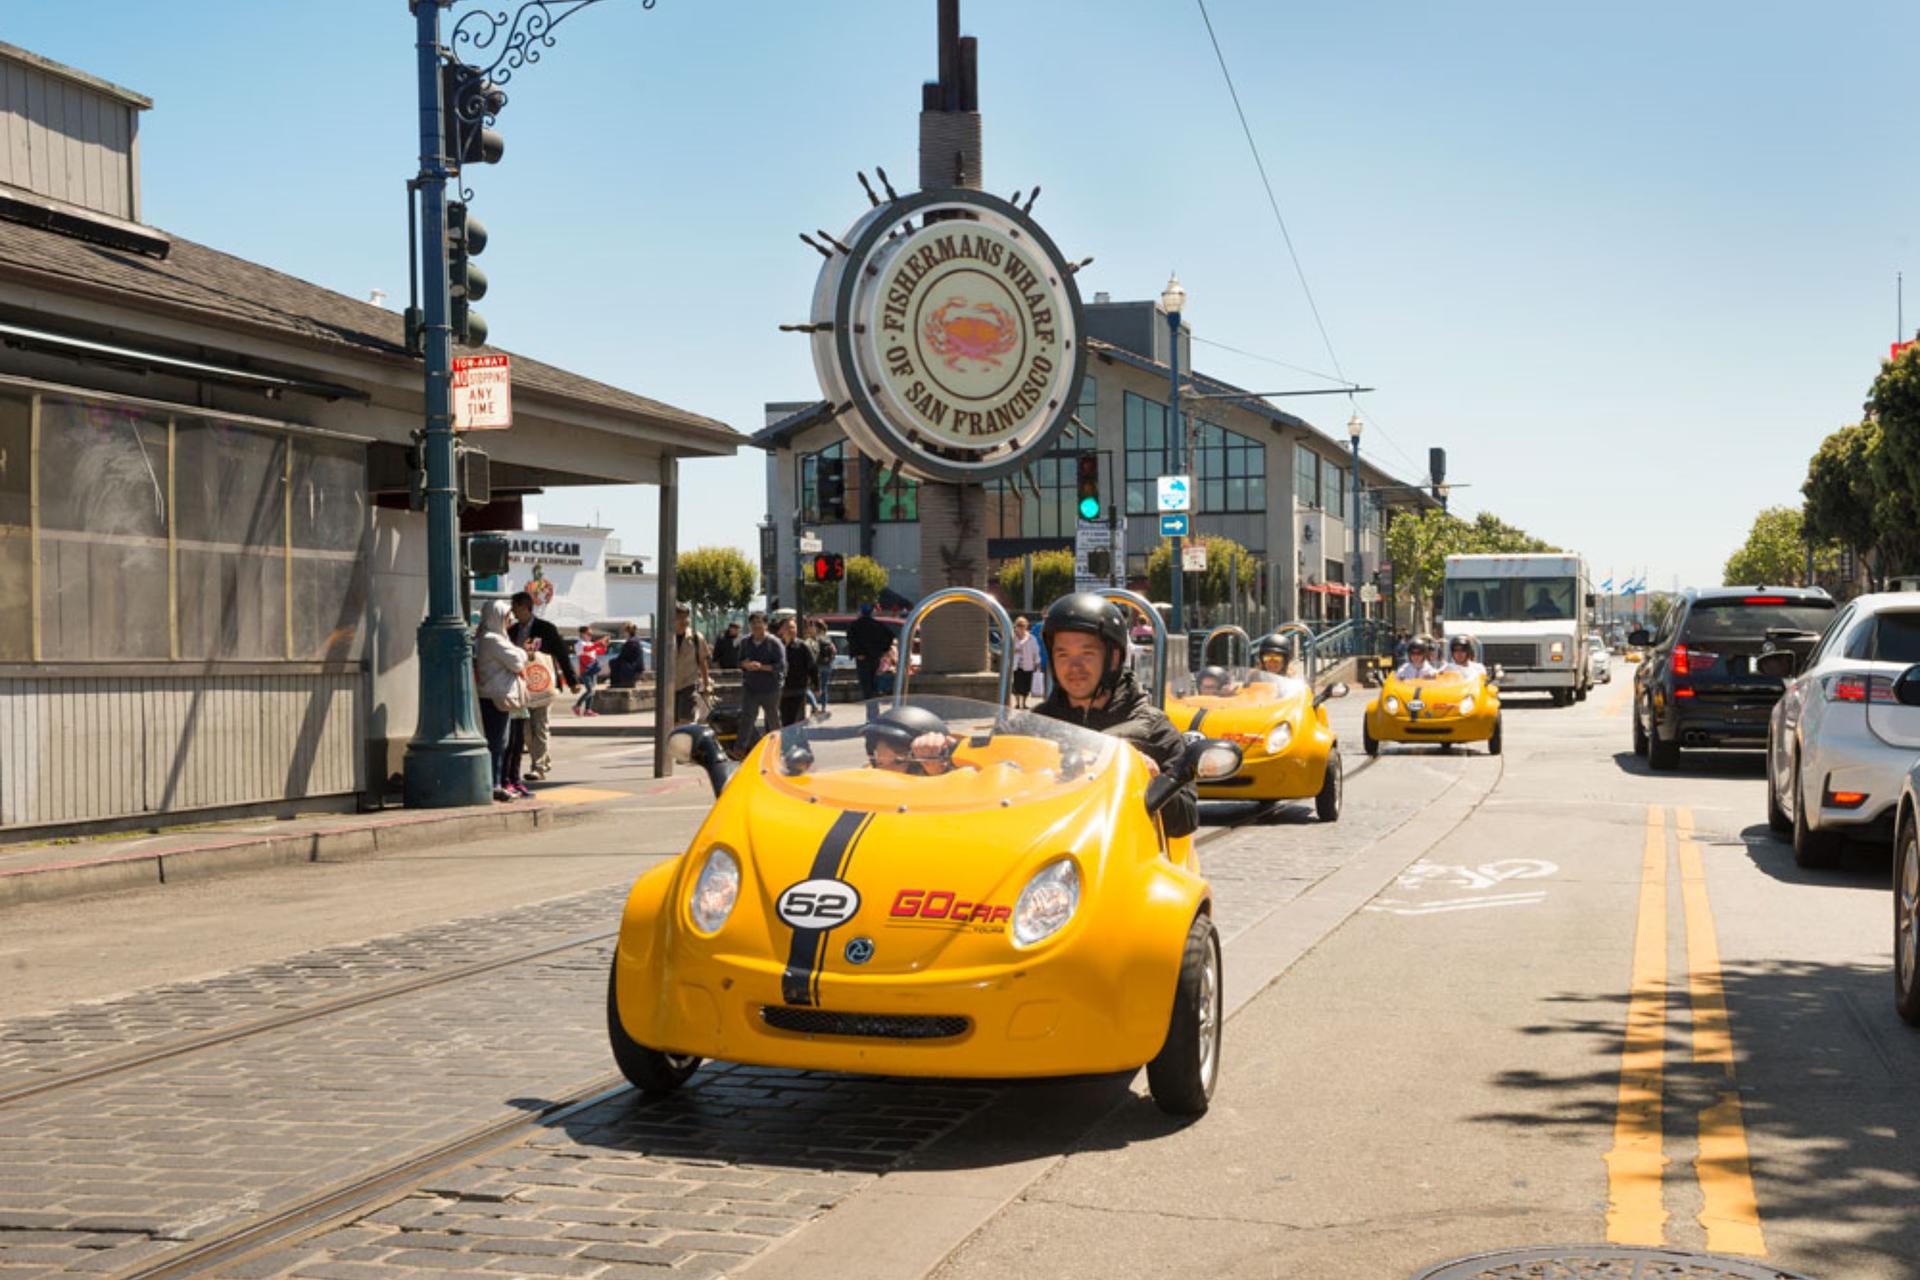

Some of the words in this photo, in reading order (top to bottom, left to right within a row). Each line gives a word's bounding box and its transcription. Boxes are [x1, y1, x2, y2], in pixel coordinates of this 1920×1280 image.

[883, 234, 1003, 332] FISHERMANS
[1003, 251, 1055, 345] WHARF
[455, 356, 505, 369] TOW-AWAY
[470, 388, 492, 400] ANY
[886, 345, 915, 378] OF
[904, 380, 950, 426] SAN
[951, 353, 1053, 436] FRANCISCO
[468, 402, 494, 415] TIME
[508, 539, 580, 556] ANCISCAN
[783, 893, 848, 919] 52
